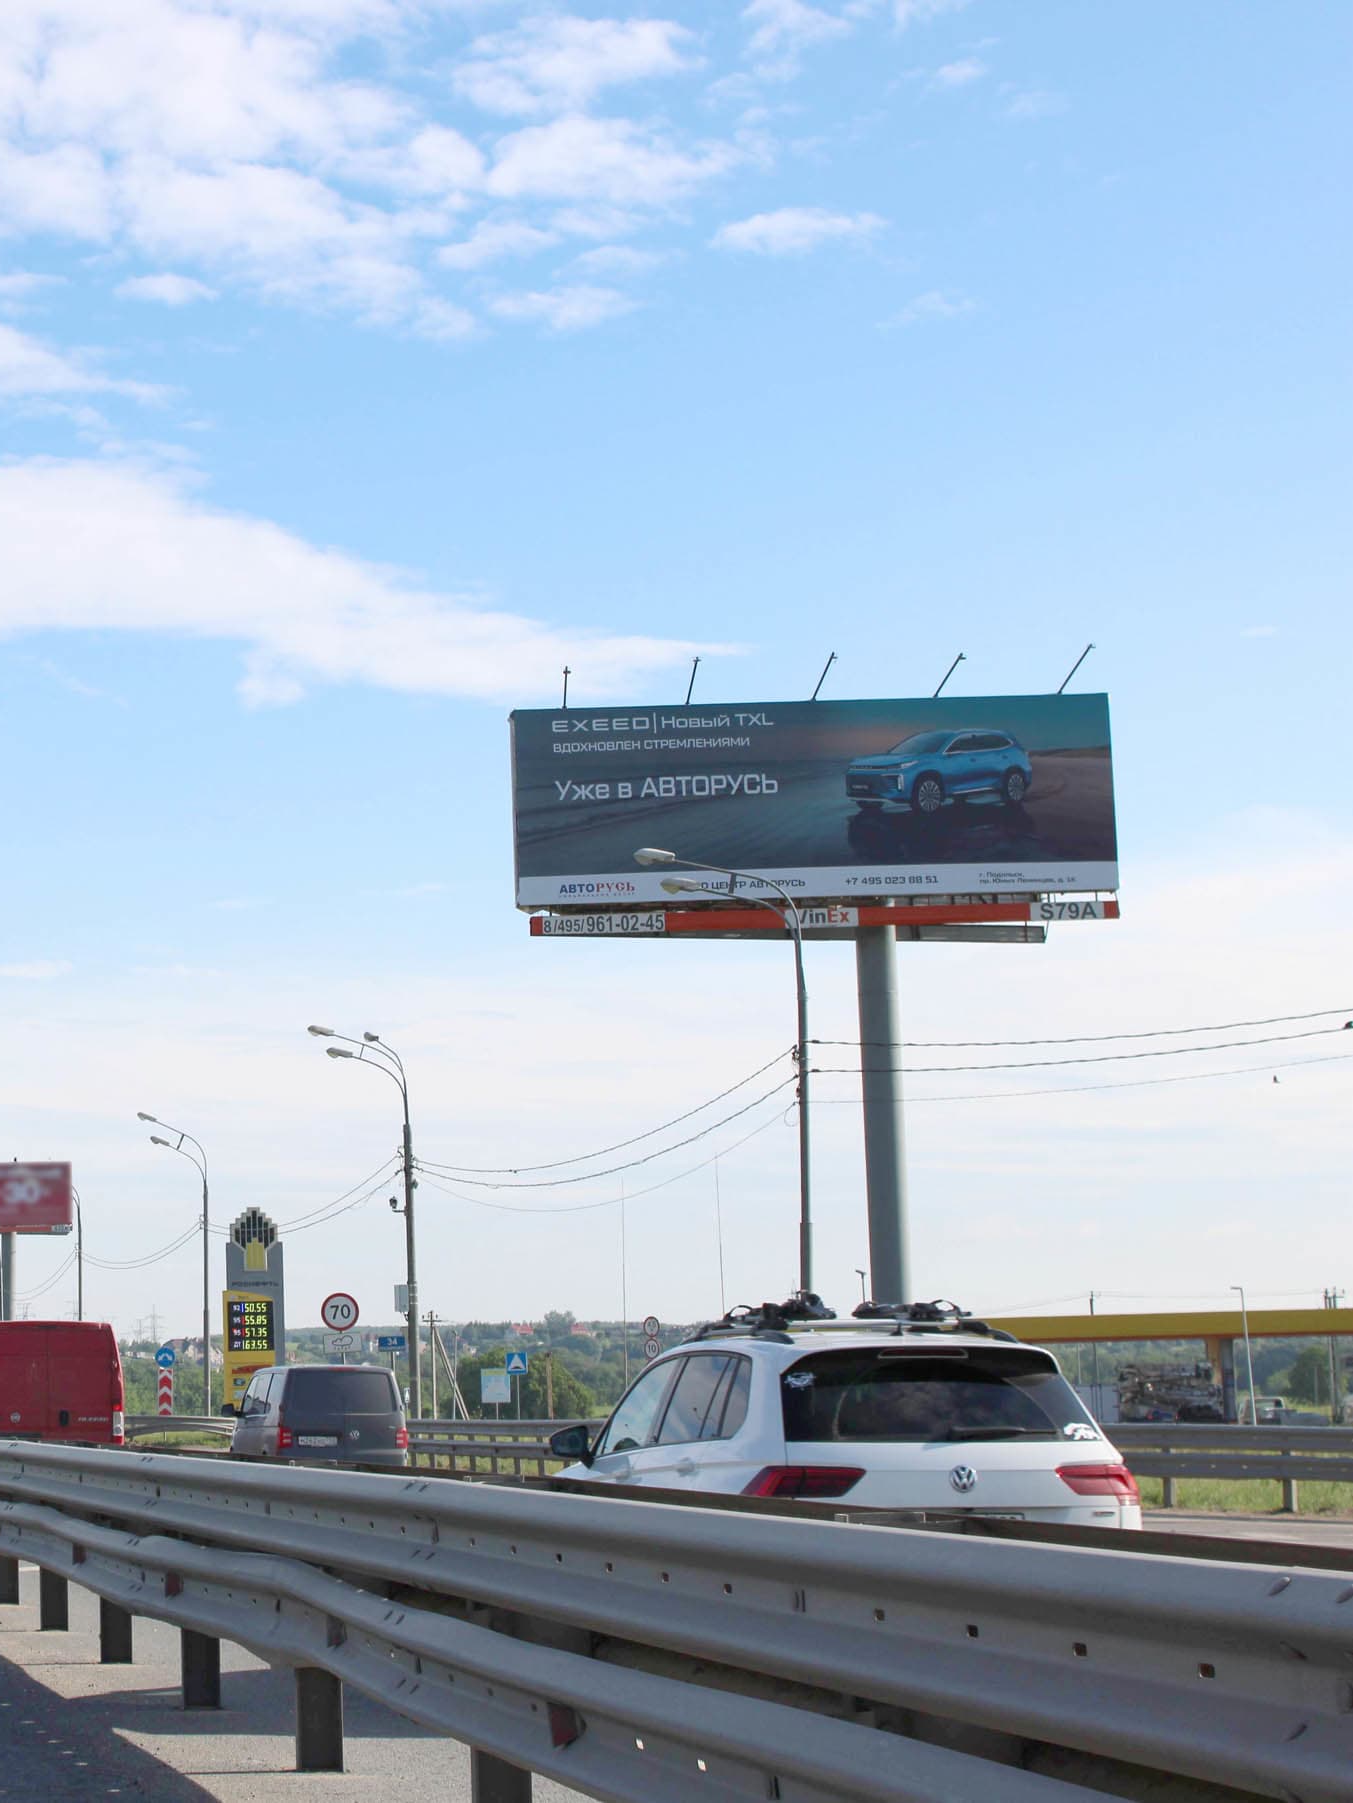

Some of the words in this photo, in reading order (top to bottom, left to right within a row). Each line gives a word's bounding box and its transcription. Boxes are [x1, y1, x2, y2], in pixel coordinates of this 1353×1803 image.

[551, 716, 650, 733] EXEED
[661, 714, 730, 729] Новый
[734, 712, 774, 727] TXL
[553, 740, 641, 754] ВДОХНОВЛЕН
[643, 736, 750, 750] СТРЕМЛЕНИЯМИ
[554, 780, 610, 800] Уже
[618, 782, 633, 798] в
[640, 773, 779, 798] АВТОРУСЬ
[559, 881, 636, 894] АВТОРУСЬ
[861, 876, 882, 885] 495
[1040, 901, 1097, 920] S79A
[244, 1302, 267, 1313] 50.55
[330, 1304, 351, 1320] 70
[244, 1315, 268, 1325] 55.85
[244, 1327, 268, 1338] 57.35
[245, 1339, 268, 1350] 63.55
